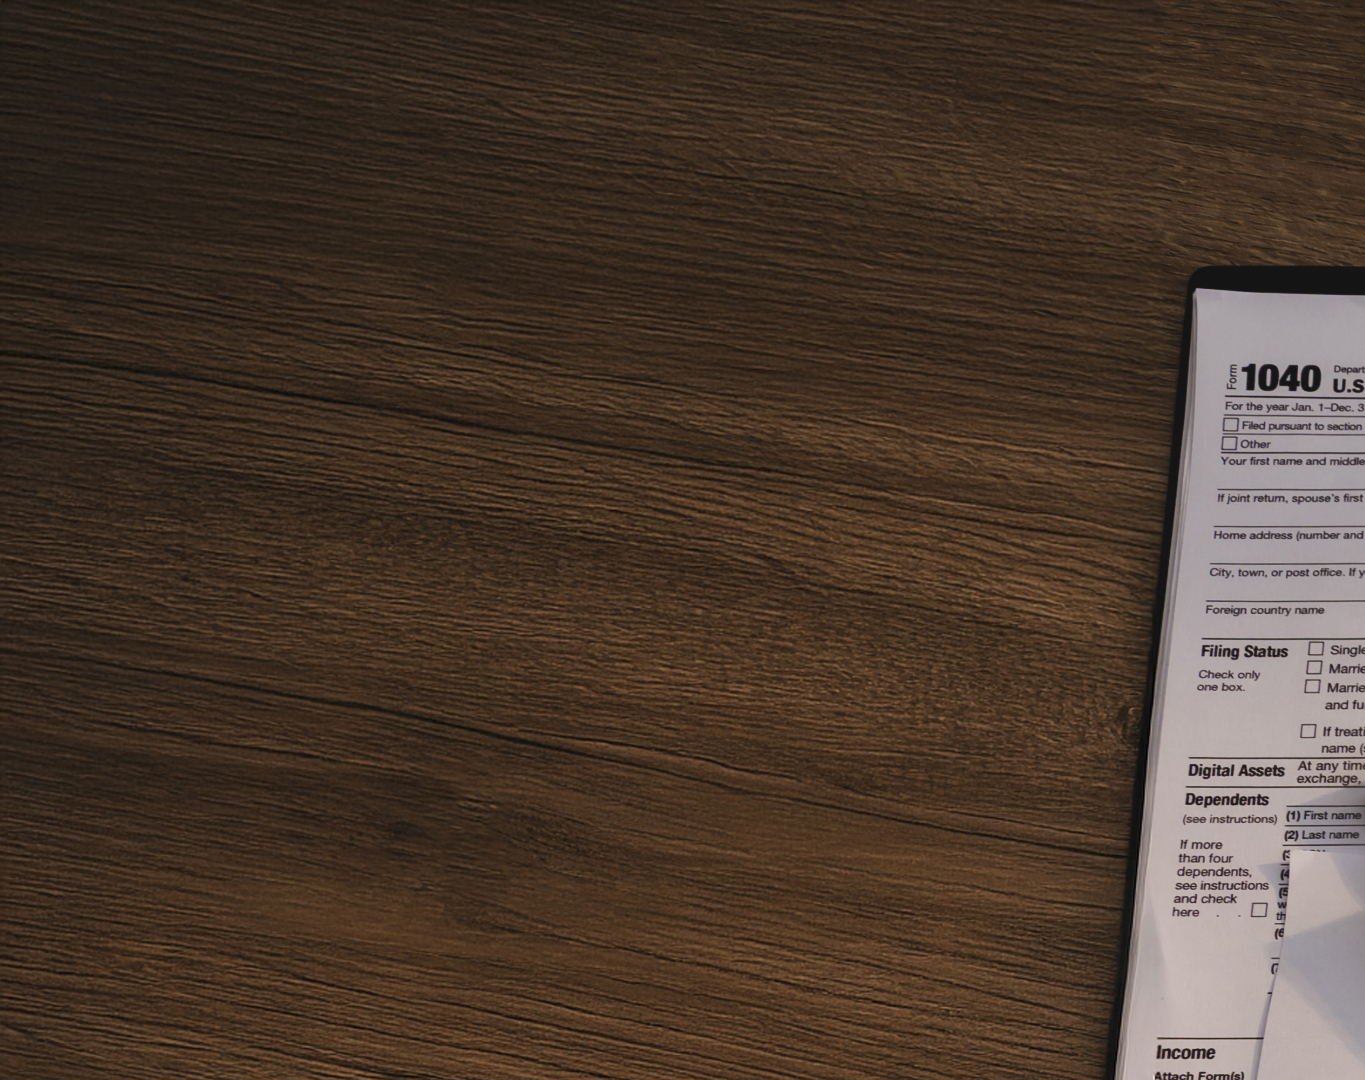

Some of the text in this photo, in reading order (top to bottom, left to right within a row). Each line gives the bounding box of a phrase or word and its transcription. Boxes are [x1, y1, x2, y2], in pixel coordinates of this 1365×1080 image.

[1226, 363, 1239, 391] Form
[1241, 363, 1322, 393] 1040
[1225, 401, 1244, 411] For
[1245, 401, 1264, 412] the
[1265, 403, 1290, 414] year
[1291, 402, 1315, 412] Jan.
[1241, 420, 1266, 431] Filed
[1268, 422, 1312, 433] pursuant
[1314, 422, 1325, 431] to
[1326, 422, 1363, 431] section
[1205, 604, 1325, 617] Foreign country name
[1201, 644, 1289, 661] Filing Status
[1188, 763, 1286, 780] Digital Assets
[1184, 792, 1270, 809] Dependents
[1156, 1044, 1216, 1060] Income
